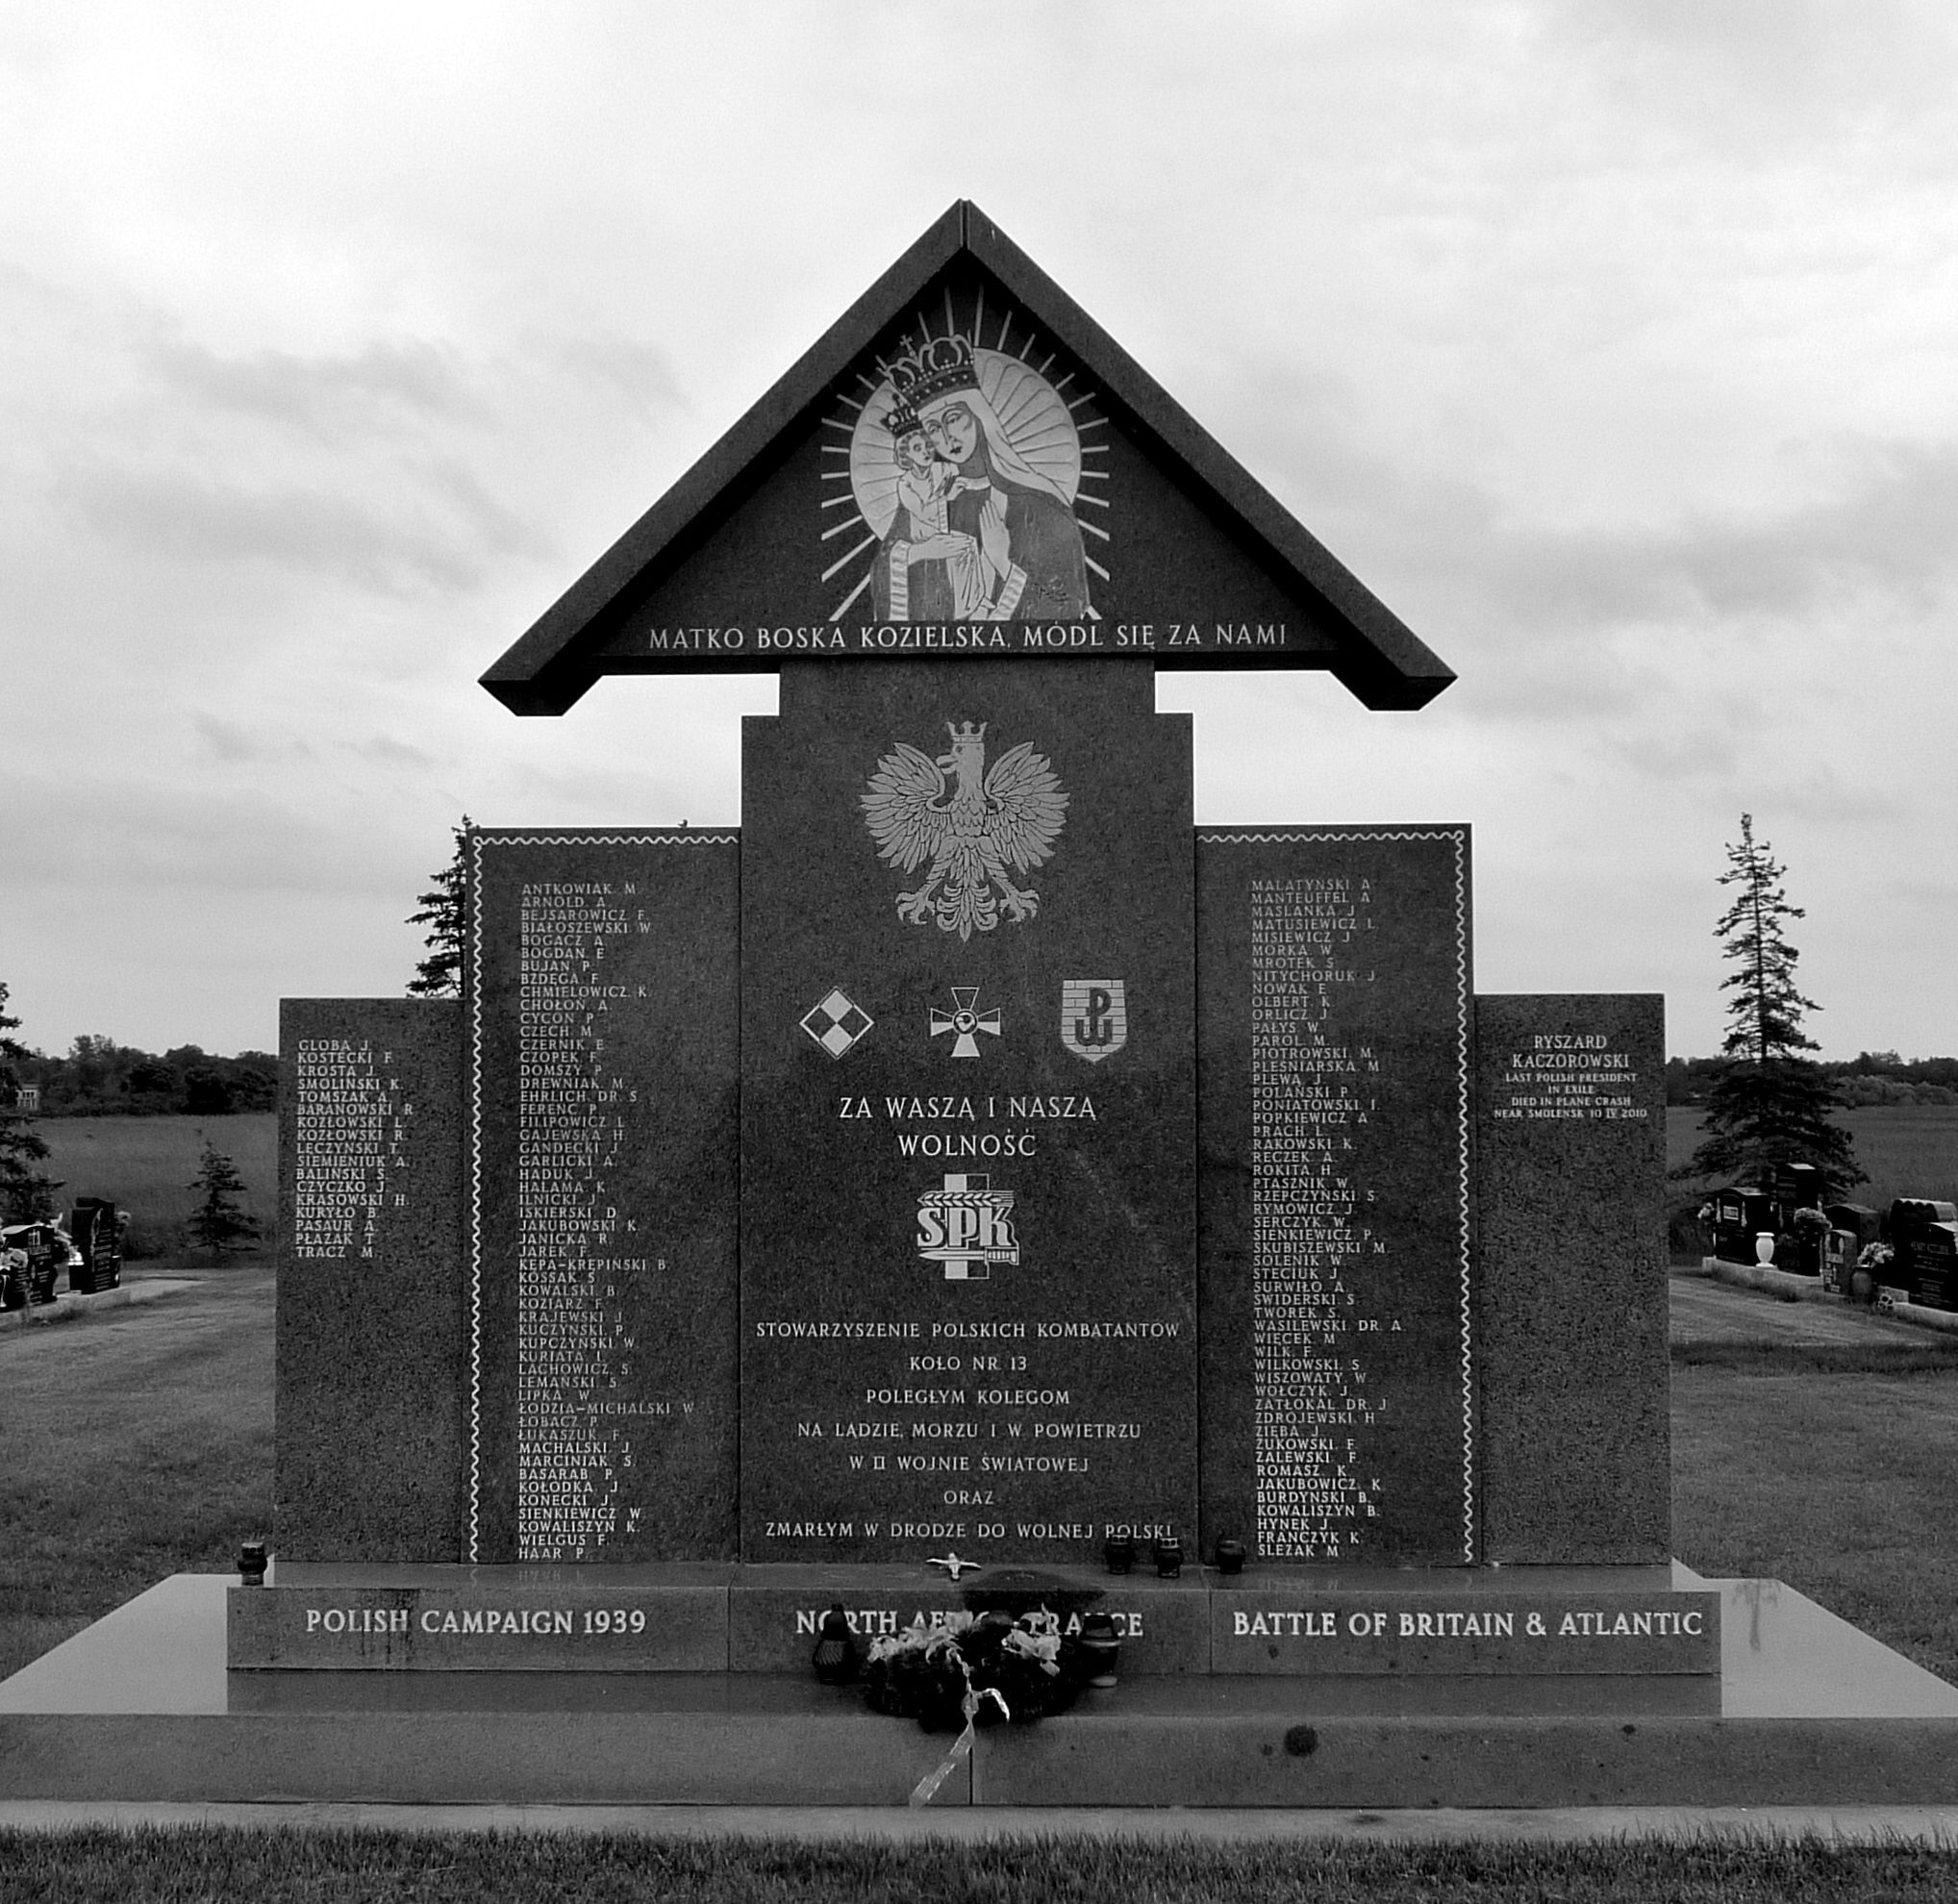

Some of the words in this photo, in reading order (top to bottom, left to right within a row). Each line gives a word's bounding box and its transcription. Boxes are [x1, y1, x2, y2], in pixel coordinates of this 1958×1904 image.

[650, 628, 743, 648] MATKO
[758, 626, 845, 648] BOSKA
[1168, 624, 1201, 644] ZA
[1217, 624, 1287, 644] NAMI
[1534, 1035, 1608, 1049] RYSZARD
[298, 1052, 371, 1064] KOSTECKI
[1512, 1054, 1629, 1068] KACZOROWSKI
[298, 1065, 356, 1077] KROSTA
[1505, 1072, 1532, 1083] LAST
[1536, 1072, 1575, 1083] POLISH
[1579, 1072, 1638, 1083] PRESIDENT
[298, 1090, 366, 1102] TOMSZAK
[1565, 1085, 1594, 1094] EXILE
[840, 1097, 872, 1118] ZA
[989, 1097, 994, 1117] I
[1511, 1097, 1538, 1107] DIED
[1556, 1096, 1591, 1107] PLANE
[1594, 1096, 1631, 1107] CRASH
[297, 1104, 391, 1115] BARANOWSKI
[1494, 1109, 1523, 1119] NEAR
[1527, 1109, 1585, 1119] SMOLENSK
[298, 1155, 385, 1167] SIEMIENIUK
[297, 1180, 365, 1193] CZYCZKO
[296, 1193, 382, 1206] KRASOWSKI
[296, 1219, 352, 1232] PASAUR
[917, 1207, 1012, 1247] SPK
[296, 1245, 345, 1259] TRACZ
[757, 1322, 919, 1338] STOWARZYSZENIE
[932, 1323, 1025, 1338] POLSKICH
[910, 1356, 961, 1370] KOŁO
[1011, 1356, 1027, 1370] 13
[978, 1390, 1070, 1405] KOLEGOM
[798, 1422, 822, 1438] NA
[913, 1423, 978, 1438] MORZU
[991, 1423, 995, 1438] I
[1007, 1423, 1022, 1438] W
[1035, 1424, 1141, 1439] POWIETRZU
[849, 1455, 864, 1470] W
[897, 1456, 969, 1471] WOJNIE
[519, 1467, 588, 1481] BASARAB
[519, 1493, 586, 1507] KONECKI
[944, 1491, 994, 1505] ORAZ
[518, 1507, 615, 1520] SIENKIEWICZ
[1258, 1504, 1354, 1516] KOWALISZYN
[518, 1520, 615, 1533] KOWALISZYN
[1258, 1517, 1309, 1530] HYNEK
[865, 1523, 879, 1538] W
[891, 1523, 966, 1539] DRODZE
[979, 1523, 1006, 1539] DO
[1017, 1523, 1093, 1539] WOLNEJ
[1258, 1531, 1339, 1543] FRANCZYK
[519, 1534, 586, 1546] WIELGUS
[518, 1546, 561, 1560] HAAR
[306, 1609, 408, 1633] POLISH
[420, 1610, 574, 1634] CAMPAIGN
[584, 1610, 646, 1634] 1939
[1233, 1612, 1337, 1636] BATTLE
[1348, 1613, 1388, 1636] OF
[1399, 1613, 1514, 1637] BRITAIN
[1526, 1613, 1547, 1637] &
[1559, 1612, 1702, 1636] ATLANTIC
